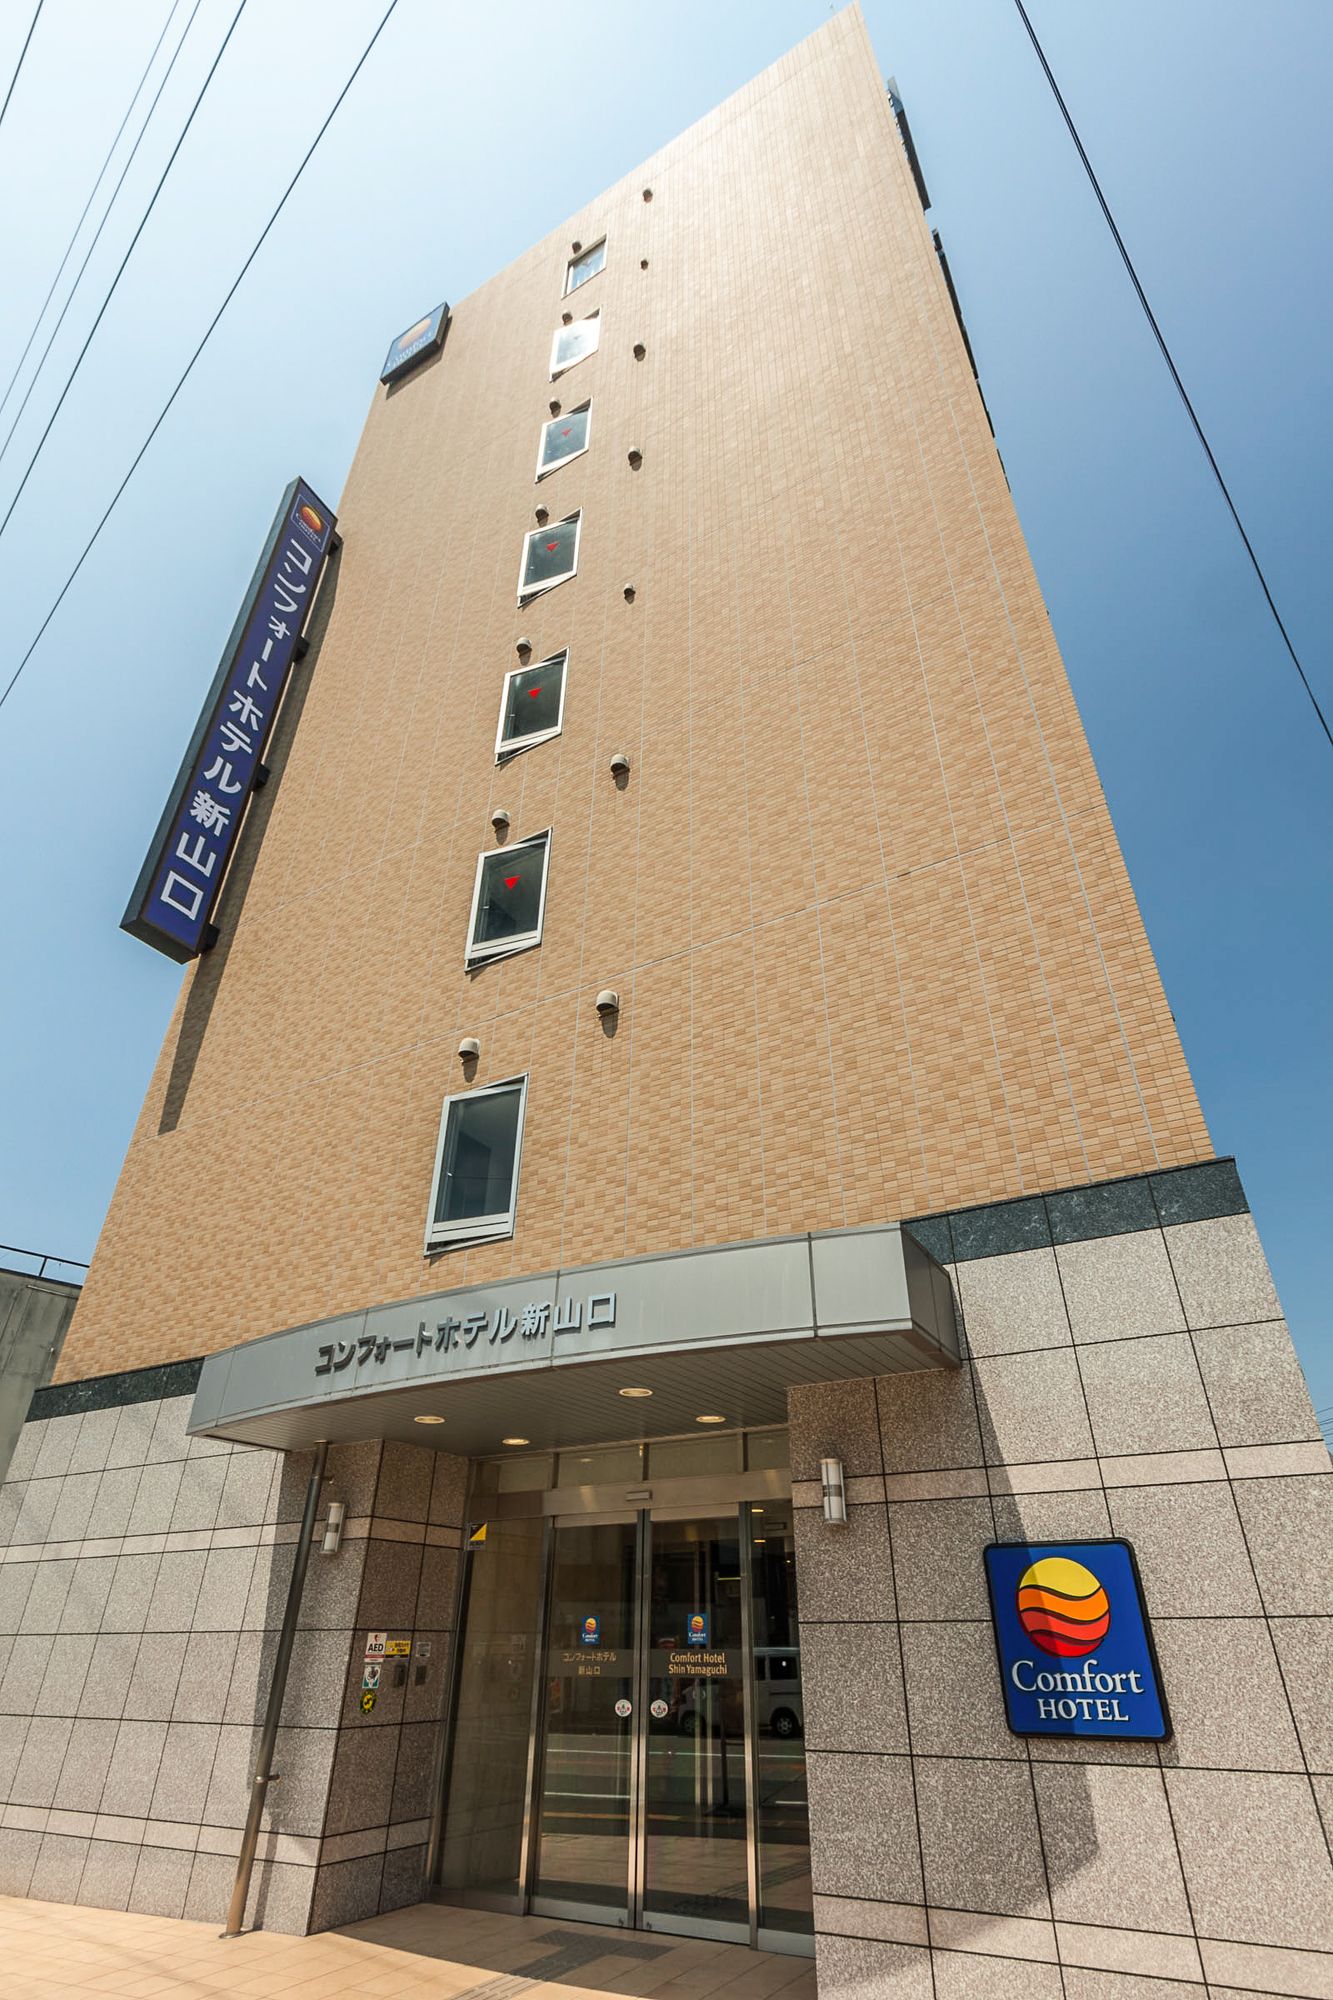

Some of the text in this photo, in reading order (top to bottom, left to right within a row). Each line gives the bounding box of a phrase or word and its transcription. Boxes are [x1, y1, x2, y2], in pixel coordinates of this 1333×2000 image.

[160, 537, 313, 922] コンフォートホテル新山口
[315, 1292, 617, 1377] コンフォートホテル新山口
[368, 1643, 384, 1653] AED
[670, 1652, 726, 1664] Comfort Hotel
[668, 1664, 728, 1677] Shin Yamaguchi
[1011, 1659, 1145, 1694] Comfort
[1037, 1698, 1129, 1722] HOTEL
